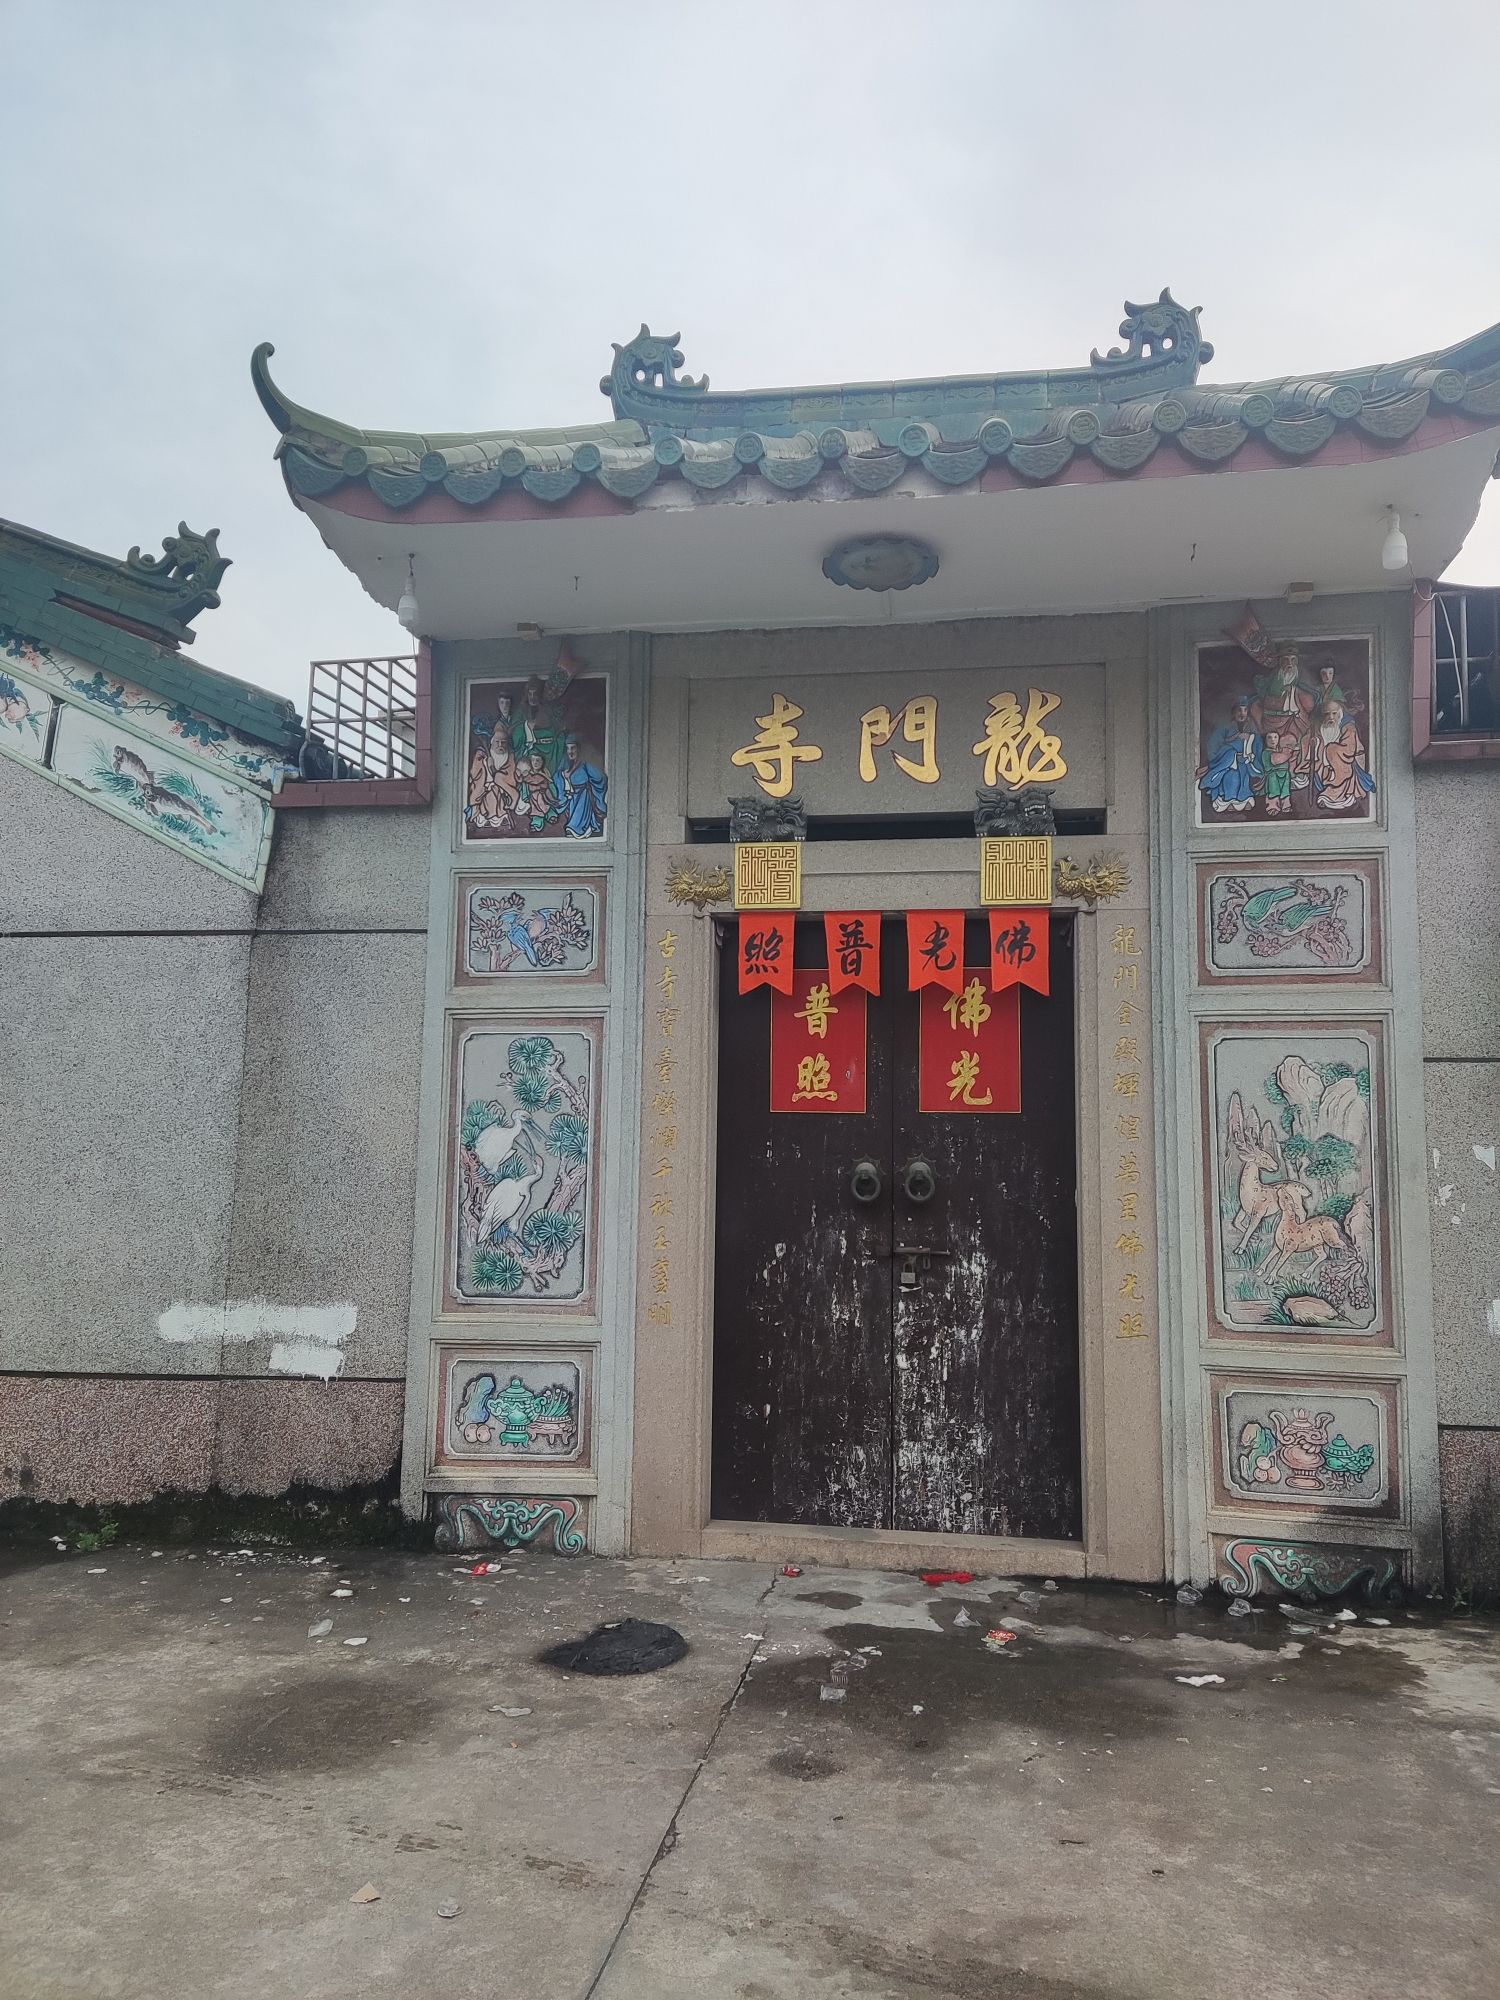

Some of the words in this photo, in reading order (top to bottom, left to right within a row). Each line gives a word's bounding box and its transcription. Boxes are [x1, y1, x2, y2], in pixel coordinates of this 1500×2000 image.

[731, 687, 1068, 797] 龍門寺
[791, 982, 839, 1102] 普照
[943, 977, 994, 1106] 佛光
